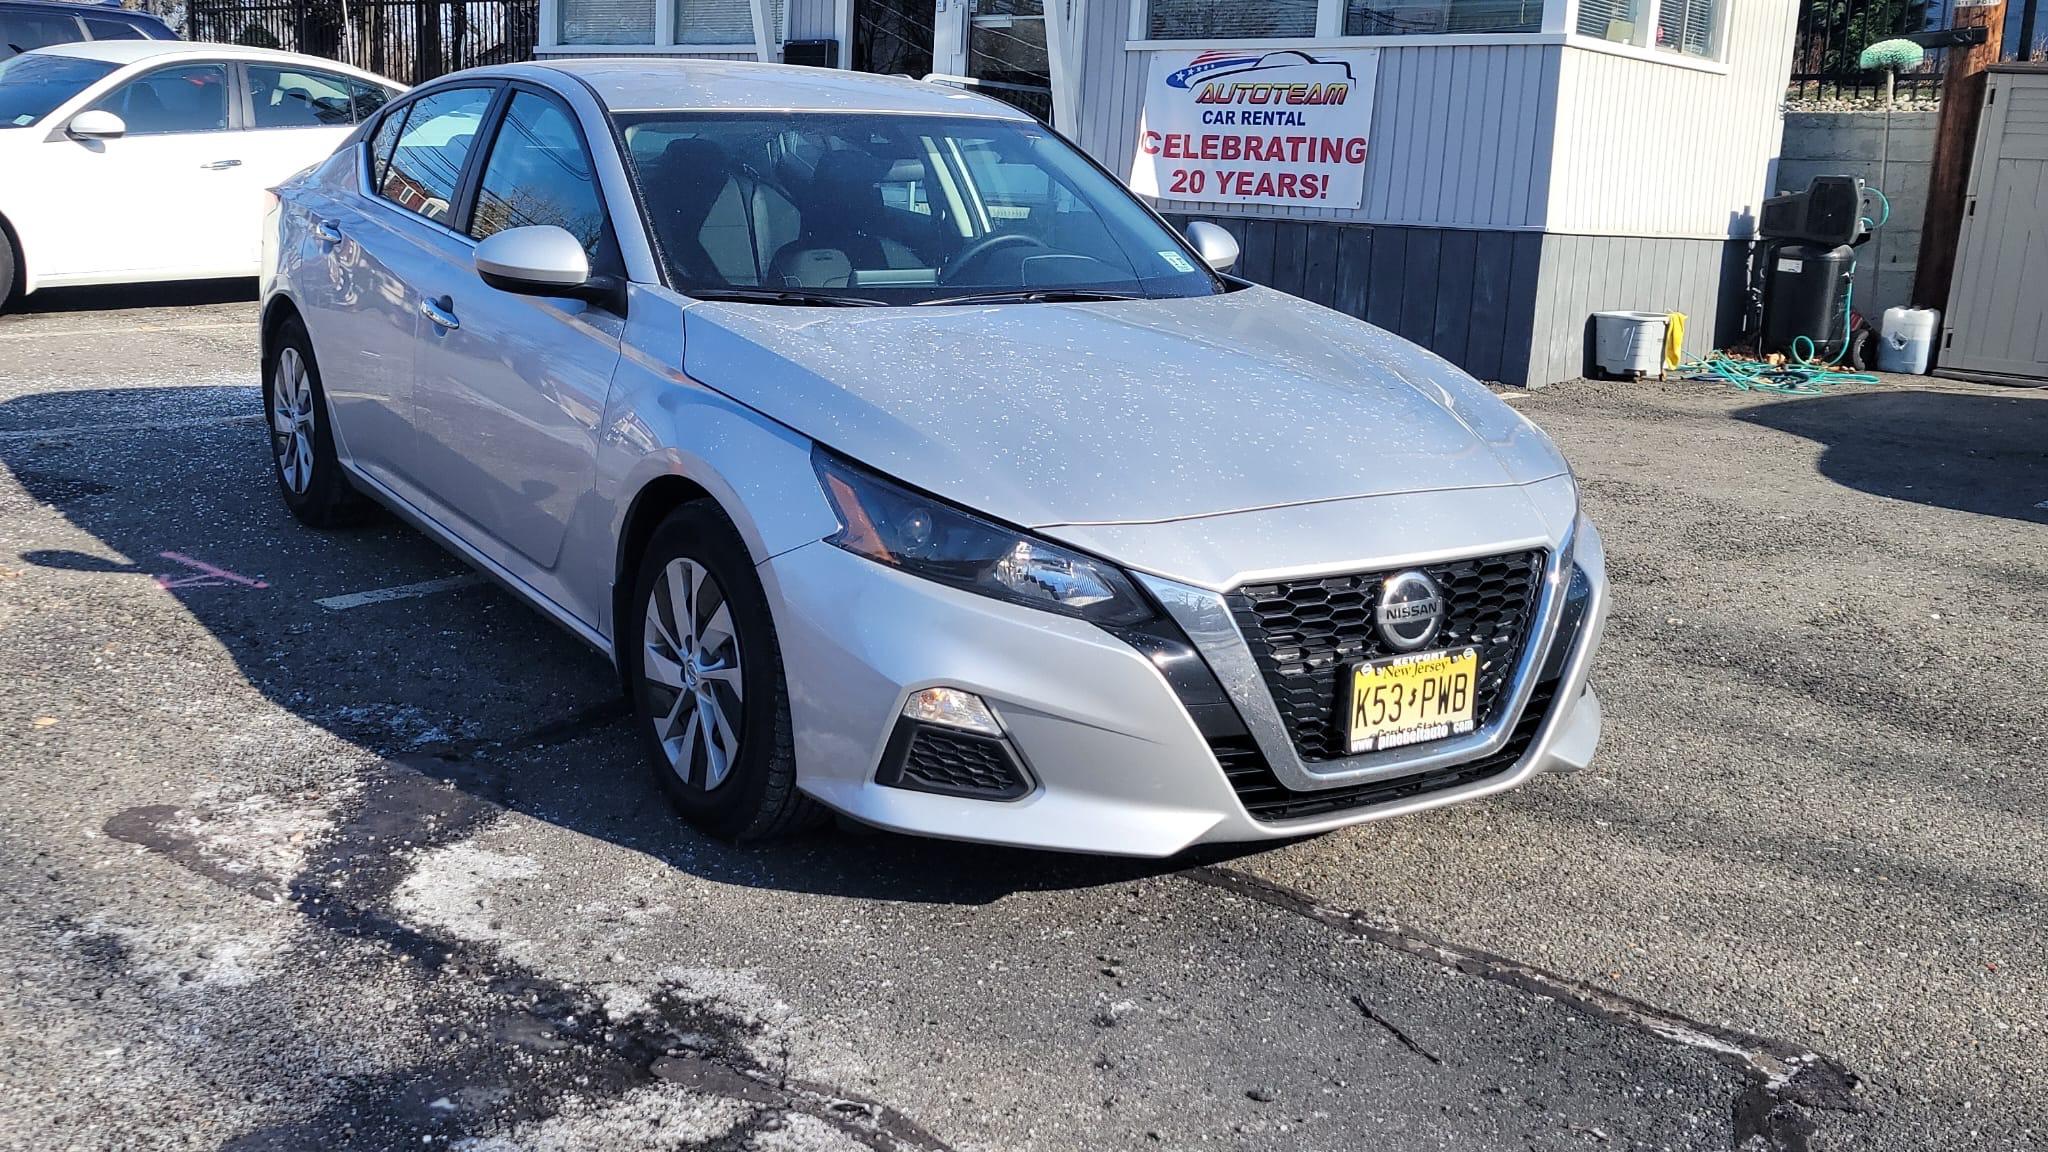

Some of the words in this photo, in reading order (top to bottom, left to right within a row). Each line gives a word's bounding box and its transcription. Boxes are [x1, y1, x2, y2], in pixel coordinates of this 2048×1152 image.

[1195, 82, 1349, 106] AUTOTEAM
[1202, 110, 1235, 125] CAR
[1240, 111, 1306, 126] RENTAL
[1141, 131, 1367, 164] CELEBRATING
[1169, 169, 1205, 194] 20
[1215, 171, 1330, 200] YEARS!
[1386, 602, 1437, 620] NISSAN
[1383, 666, 1413, 679] New
[1411, 661, 1449, 677] Jersey
[1354, 683, 1403, 729] K53
[1420, 673, 1468, 718] PWB
